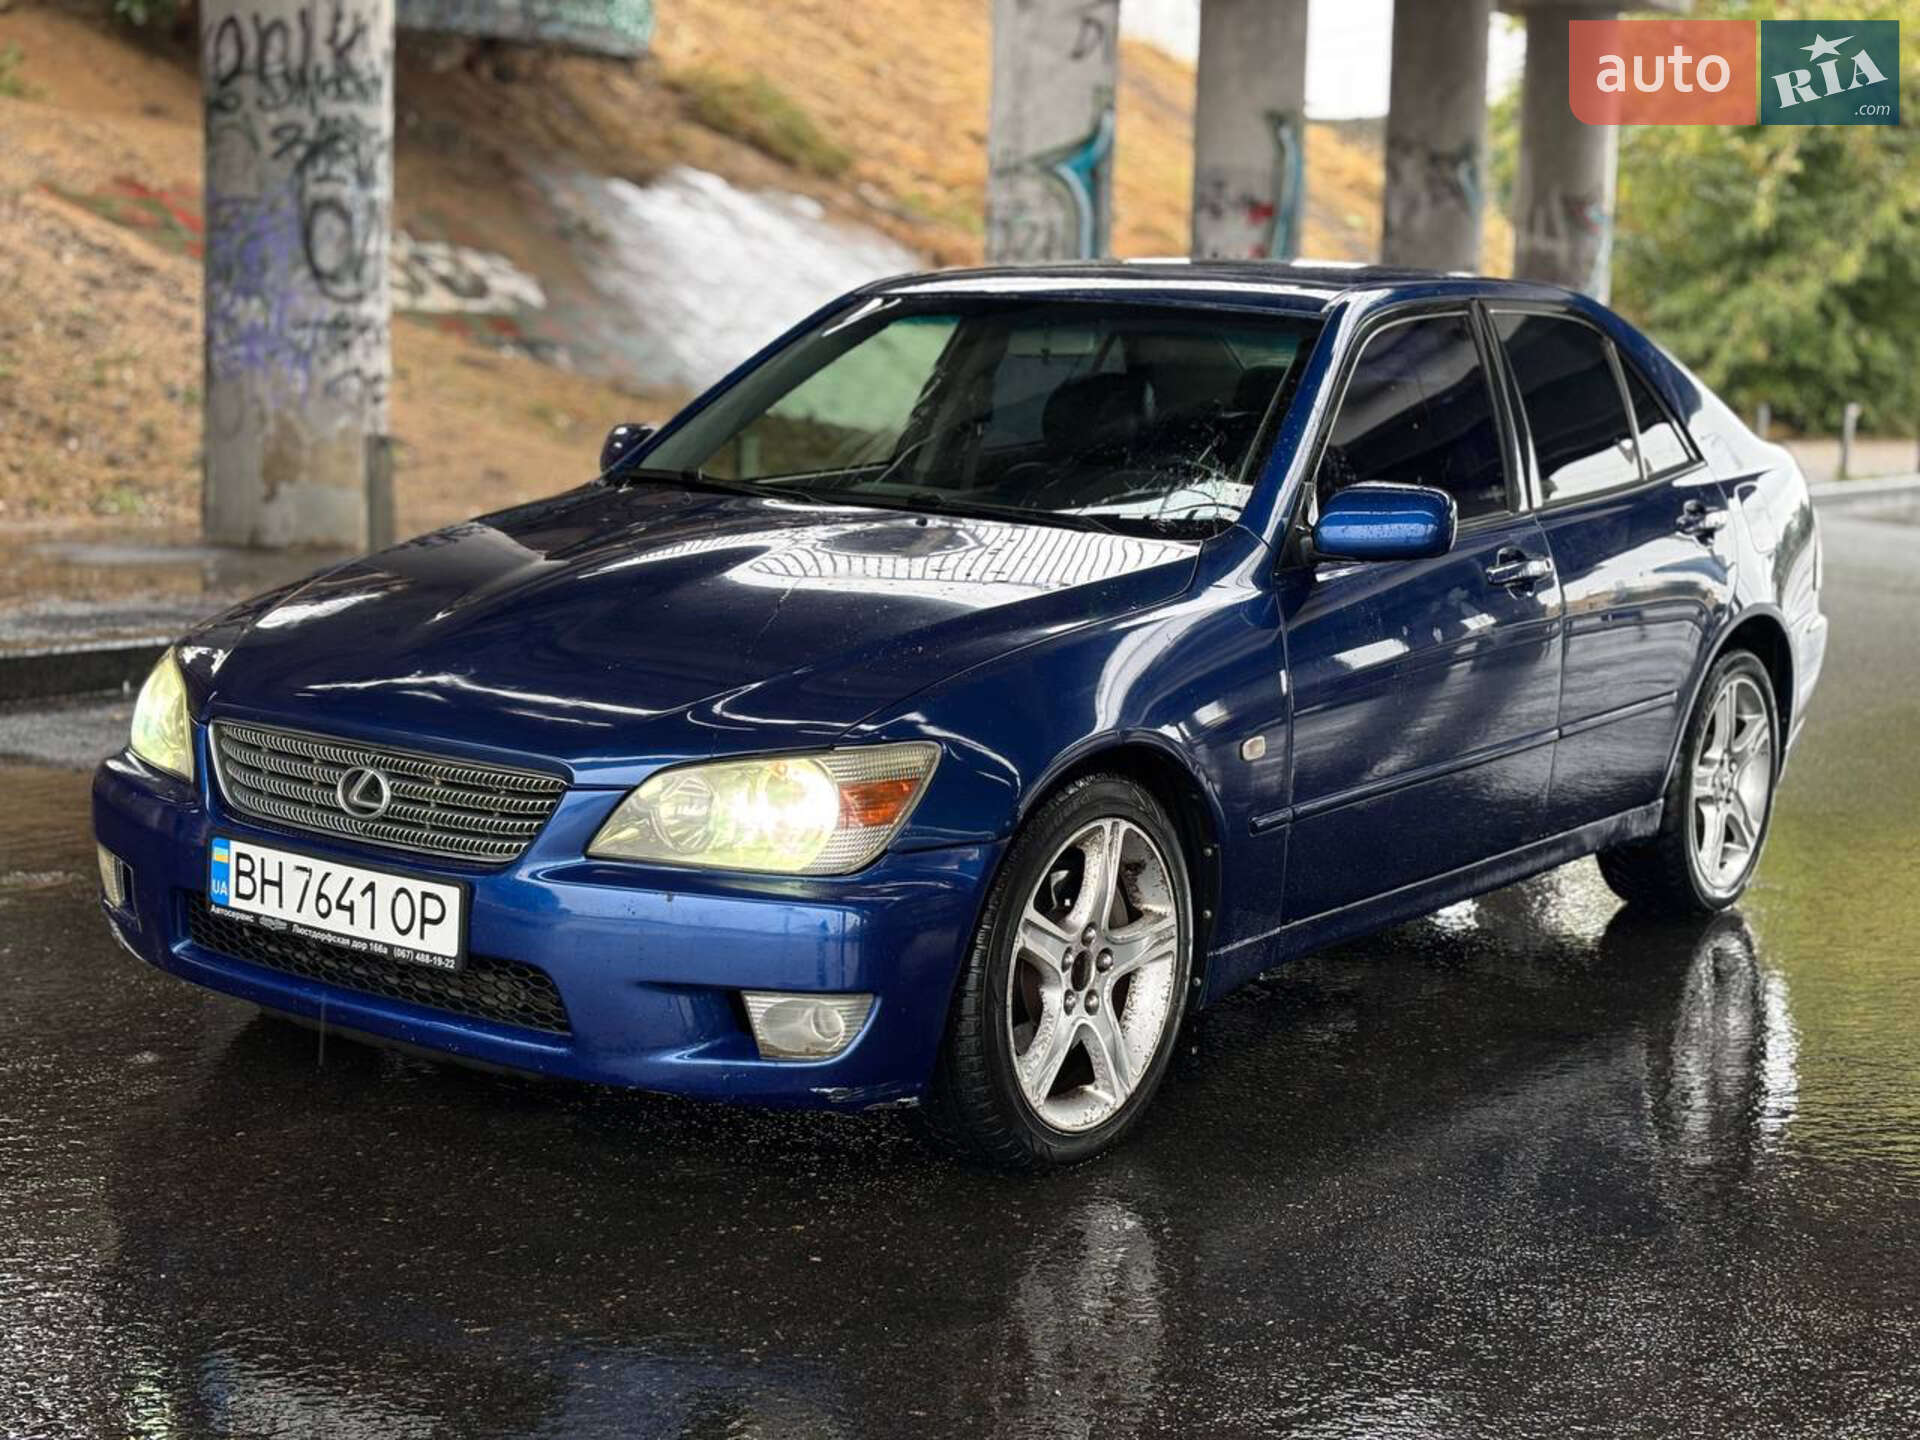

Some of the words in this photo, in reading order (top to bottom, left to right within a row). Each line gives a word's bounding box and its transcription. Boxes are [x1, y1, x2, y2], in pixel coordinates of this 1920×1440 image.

[212, 879, 229, 896] UA
[236, 851, 283, 908] BH
[294, 865, 375, 930] 7641
[391, 887, 446, 940] OP
